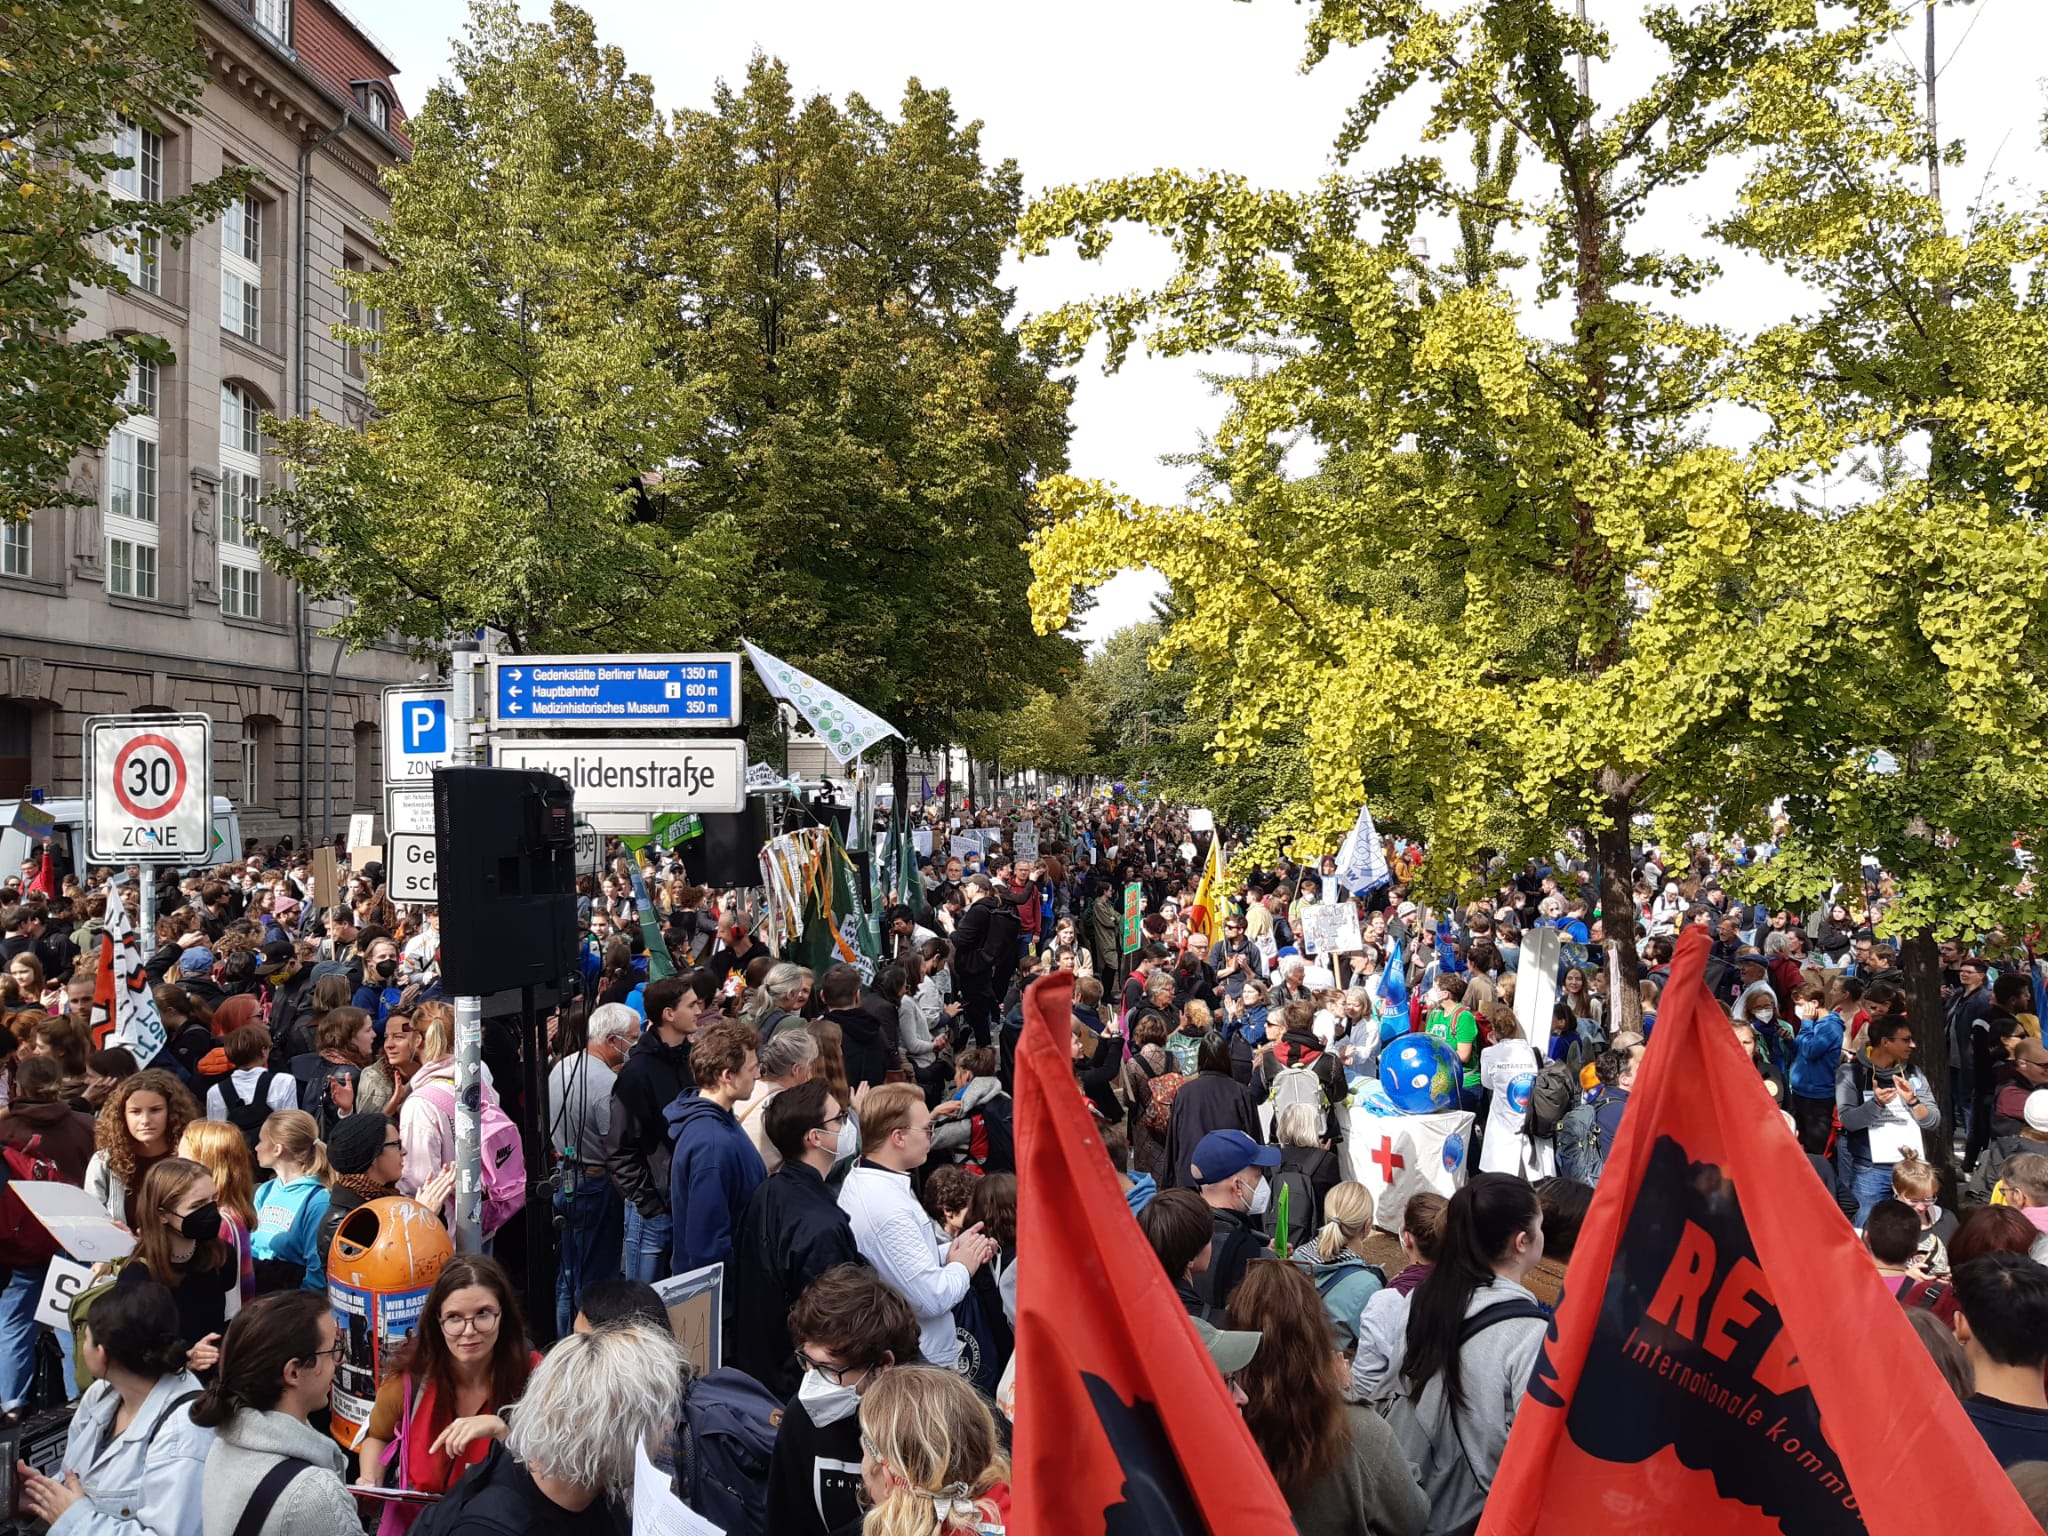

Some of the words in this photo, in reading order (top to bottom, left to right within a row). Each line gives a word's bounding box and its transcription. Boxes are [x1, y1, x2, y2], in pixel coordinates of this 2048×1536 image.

[533, 668, 595, 682] Gedenkstätte
[598, 668, 635, 681] Berliner
[637, 668, 669, 680] Mauer
[681, 668, 705, 680] 1350
[708, 670, 718, 679] m
[533, 685, 599, 698] Hauptbahnhof
[686, 685, 705, 697] 600
[708, 687, 718, 697] m
[533, 702, 625, 714] Medizinhistorisches
[627, 702, 669, 714] Museum
[686, 701, 705, 713] 350
[708, 704, 718, 713] m
[411, 707, 436, 747] P
[128, 757, 170, 797] 30
[122, 826, 178, 847] ZONE
[406, 844, 435, 864] Ge
[575, 834, 594, 860] aße
[405, 872, 438, 890] sch
[496, 1143, 512, 1162] NIKE
[386, 1299, 405, 1312] WIR
[405, 1293, 428, 1308] RASE
[1621, 1326, 1765, 1427] Internationale
